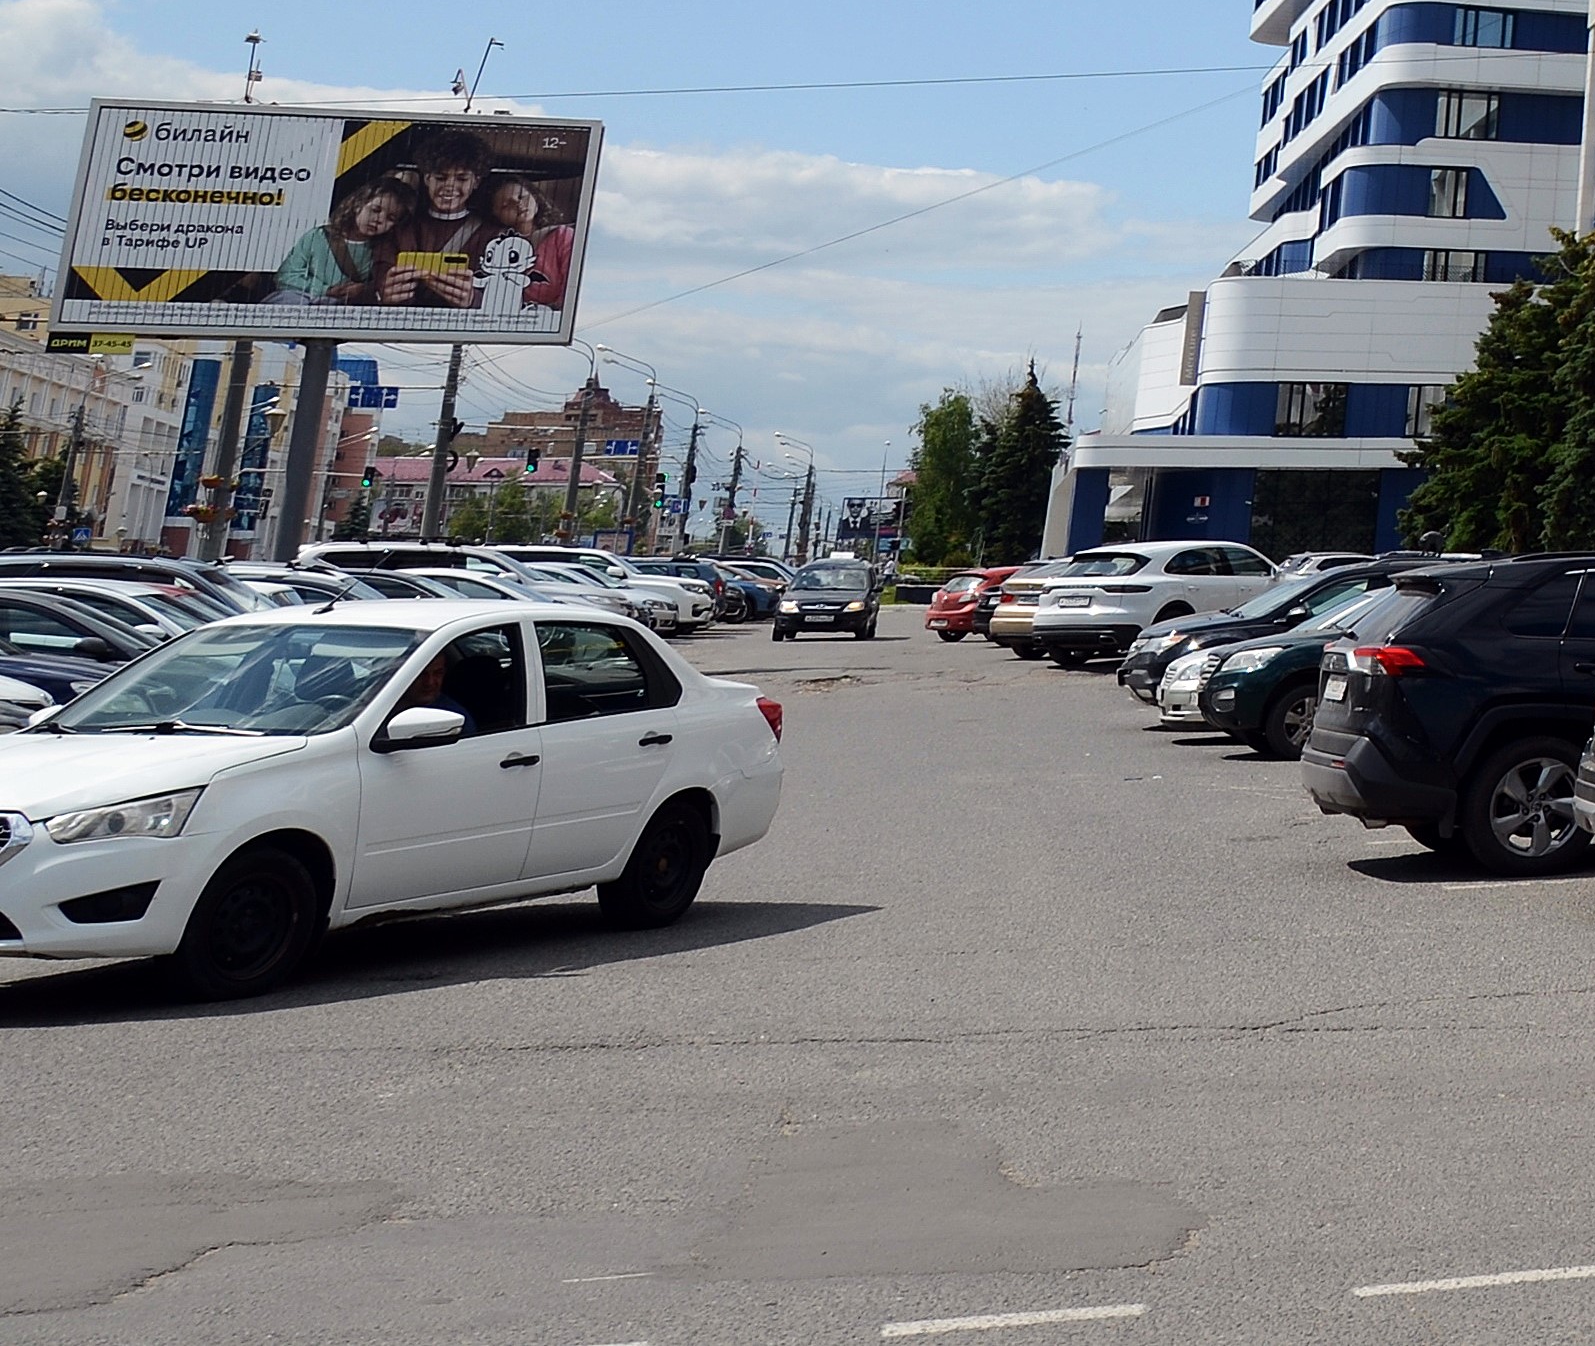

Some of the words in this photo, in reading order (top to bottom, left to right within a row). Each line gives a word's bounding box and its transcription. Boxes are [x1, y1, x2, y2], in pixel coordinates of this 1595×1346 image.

[155, 122, 250, 144] билайн
[116, 156, 221, 183] Смотри
[229, 166, 311, 183] видео
[110, 183, 283, 206] бесконечно!
[104, 219, 171, 233] Выбери
[174, 223, 244, 235] дракона
[101, 237, 110, 246] в
[116, 235, 181, 250] Тарифе
[185, 237, 208, 248] UP
[92, 339, 132, 349] 37-45-45
